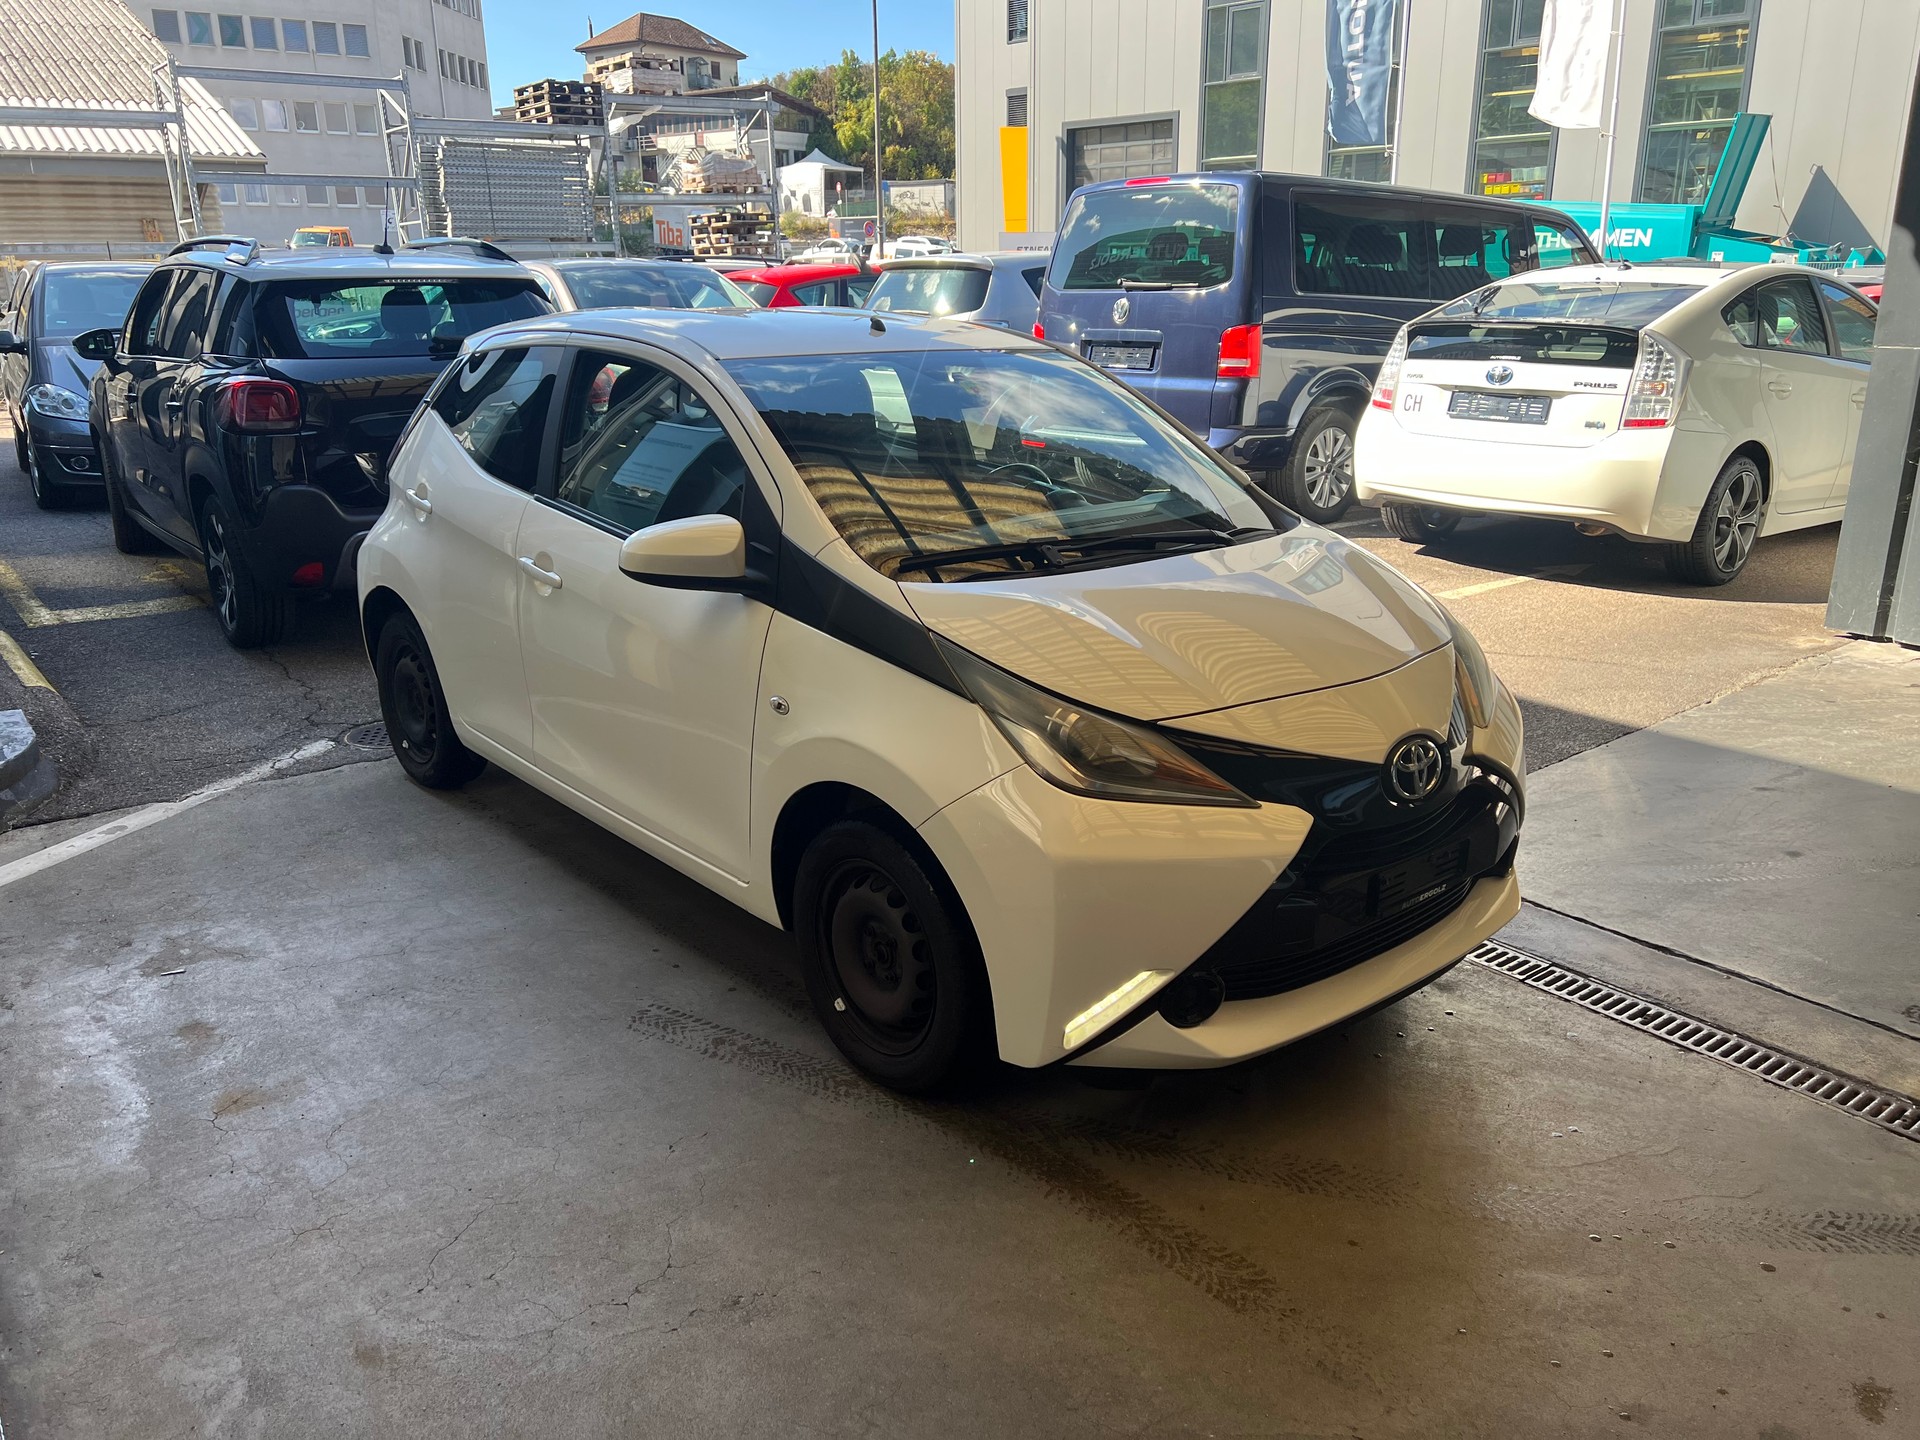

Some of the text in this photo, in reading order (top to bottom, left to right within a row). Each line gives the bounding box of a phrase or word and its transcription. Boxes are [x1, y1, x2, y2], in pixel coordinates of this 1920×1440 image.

[655, 219, 683, 246] Tiba
[1573, 381, 1618, 389] PRIUS
[1403, 393, 1423, 412] CH
[1402, 884, 1447, 909] AUTOERGOLZ
